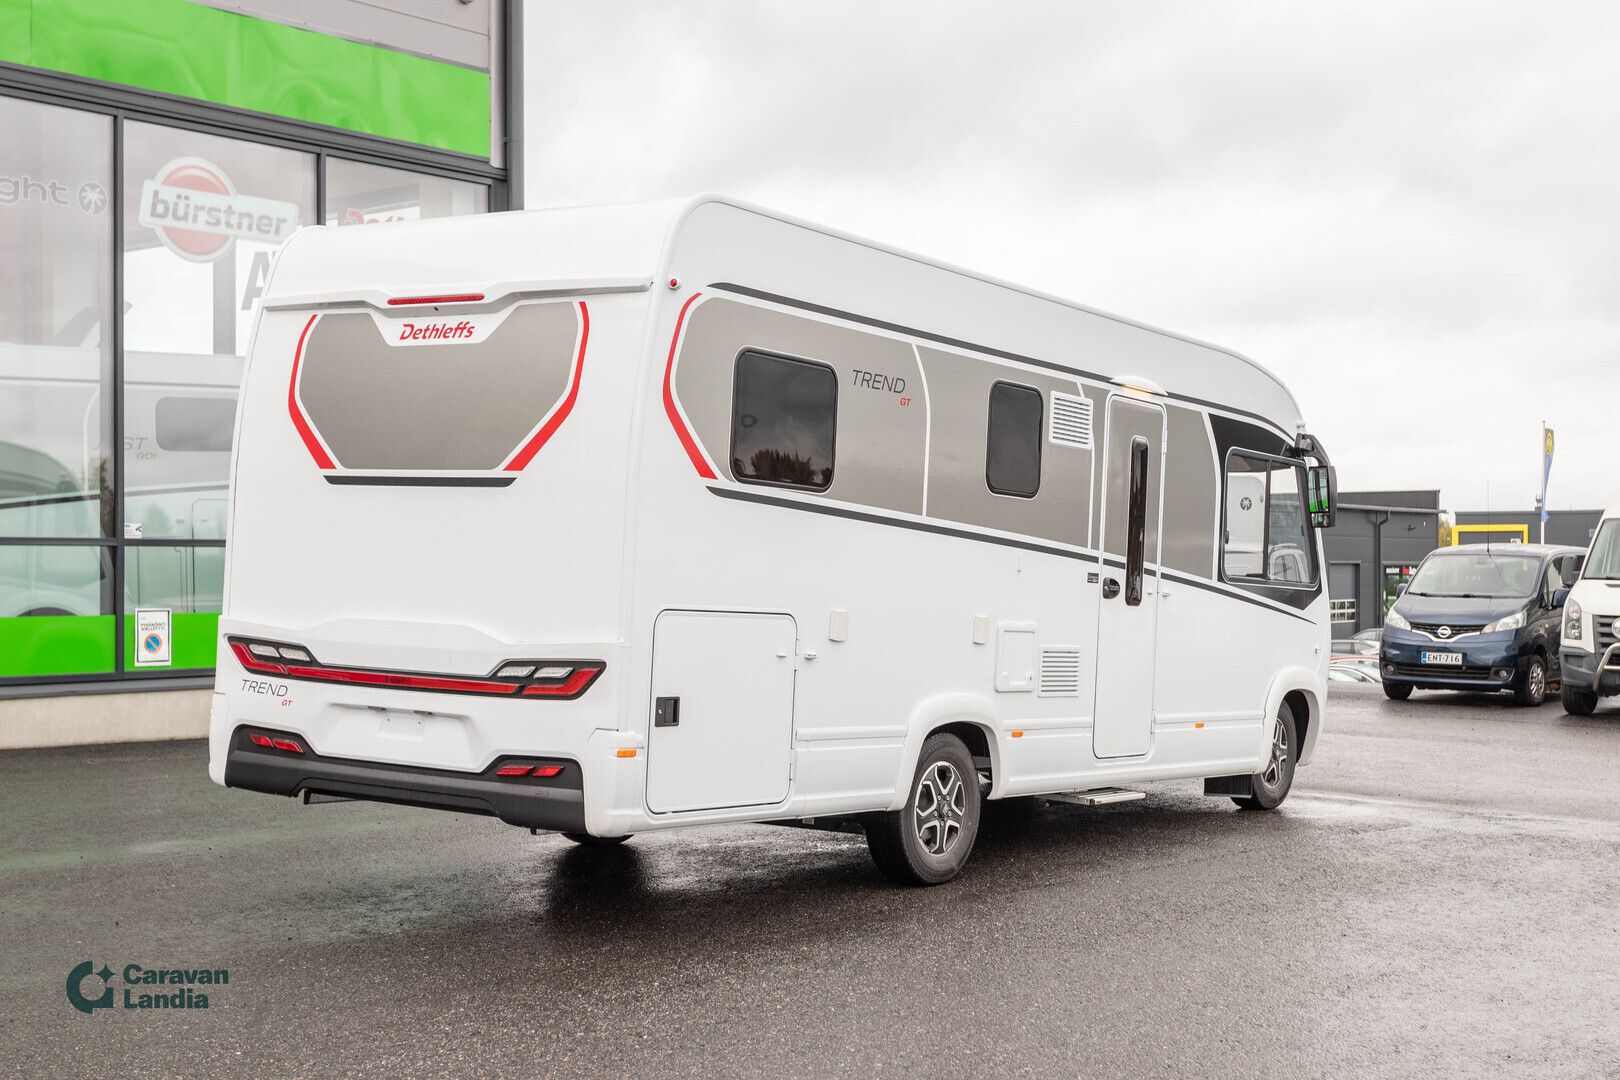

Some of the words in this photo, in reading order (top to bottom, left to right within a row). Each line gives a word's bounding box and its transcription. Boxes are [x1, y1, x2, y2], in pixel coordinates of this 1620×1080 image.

[150, 189, 287, 236] bürstner
[399, 321, 475, 340] Dethleffs
[852, 369, 906, 394] TREND
[899, 397, 912, 406] GT
[1427, 654, 1460, 663] ENT-716
[241, 679, 289, 697] TREND
[281, 699, 293, 707] GT
